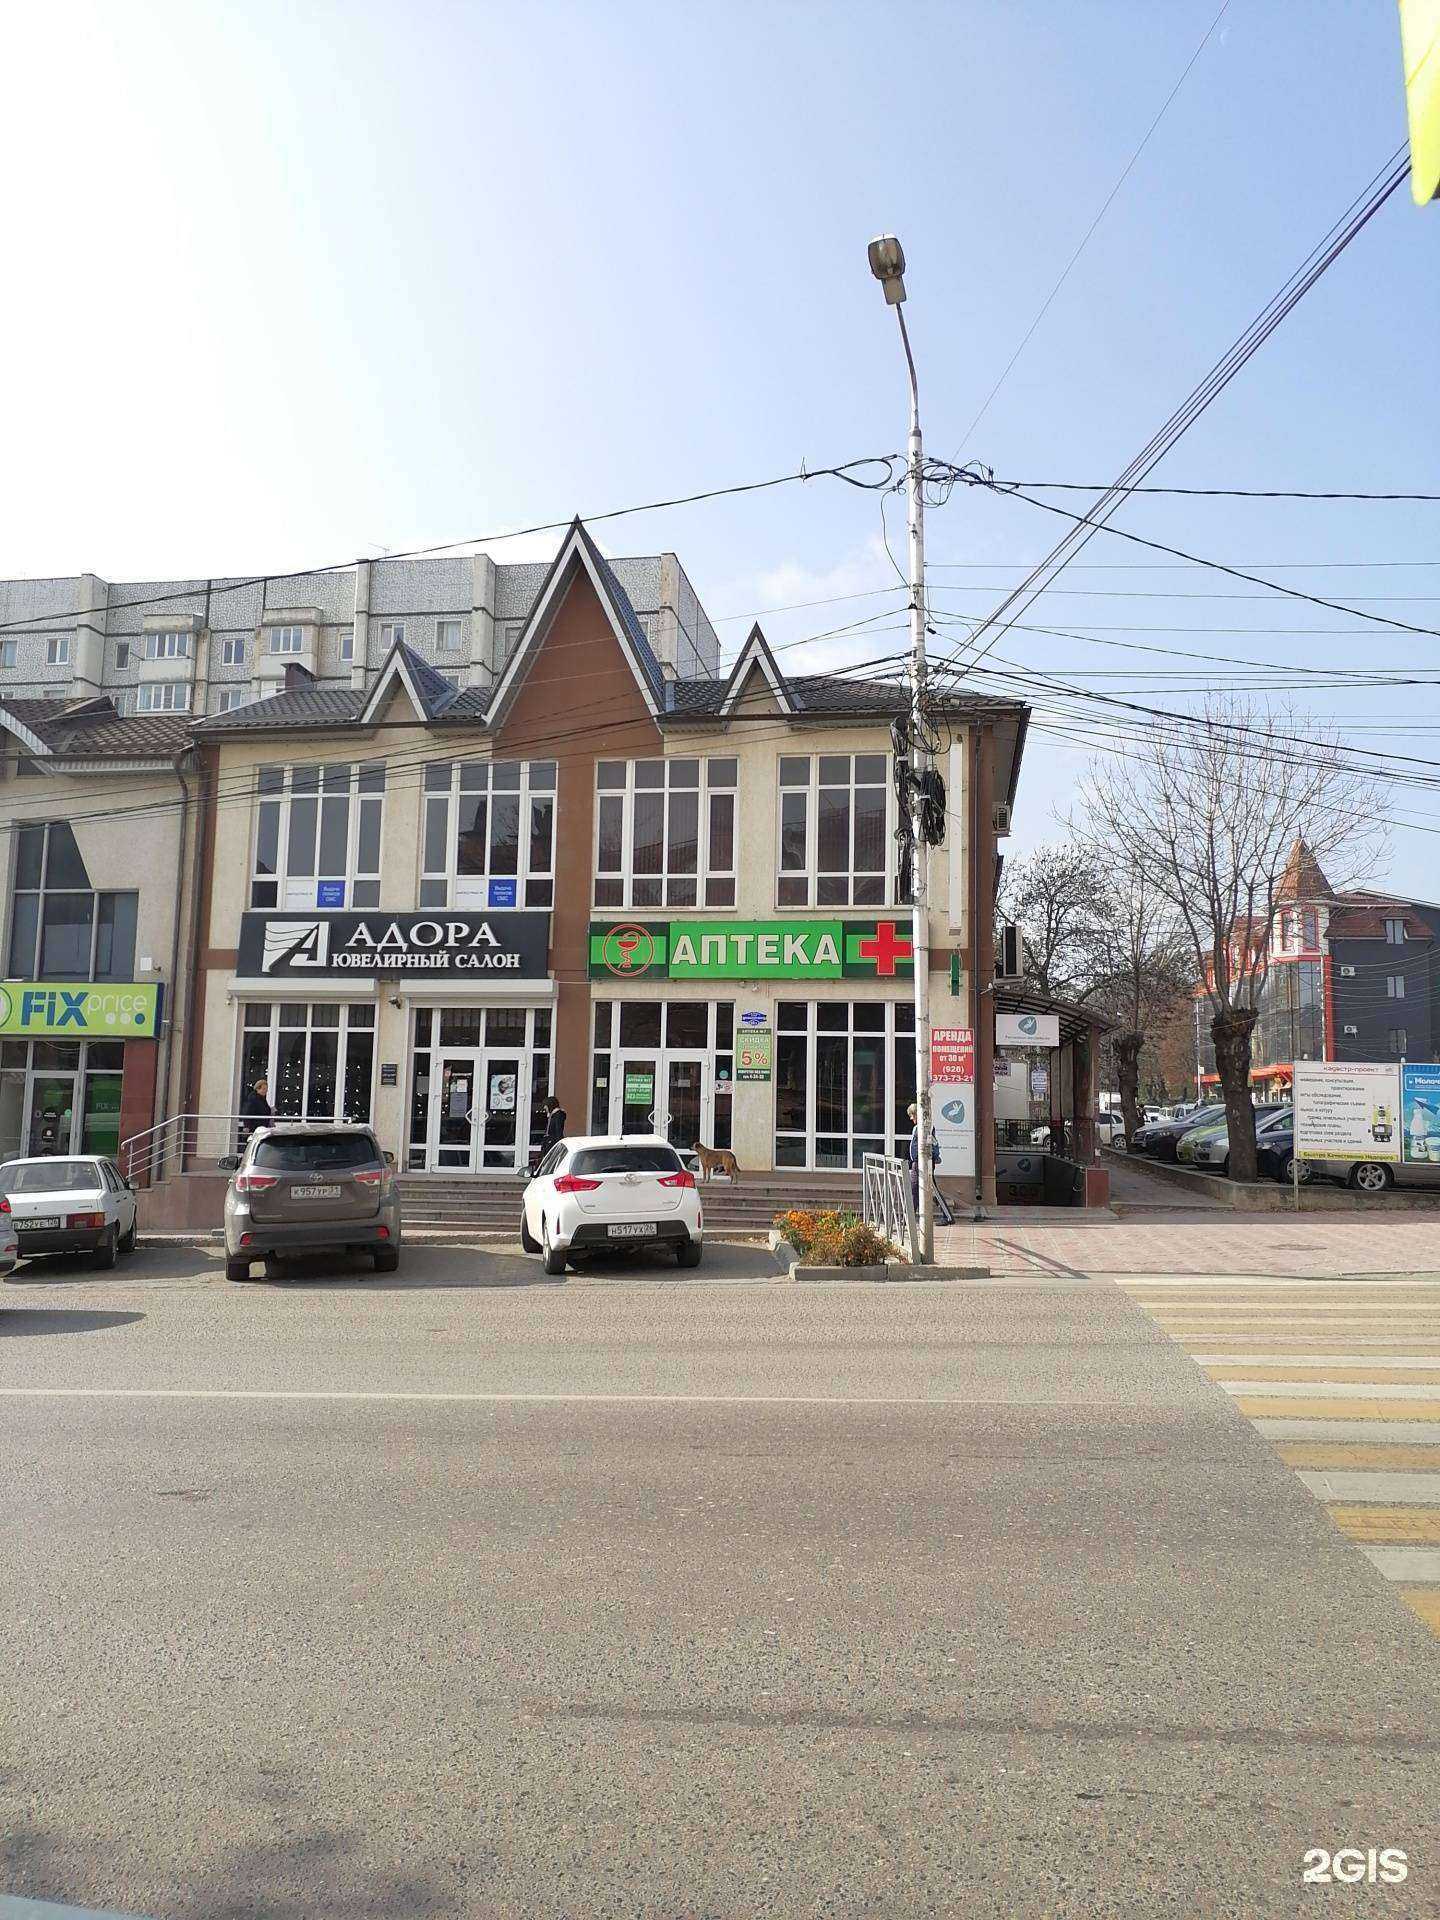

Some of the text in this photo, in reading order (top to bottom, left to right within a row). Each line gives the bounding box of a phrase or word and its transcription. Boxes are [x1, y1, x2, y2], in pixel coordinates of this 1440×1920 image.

[345, 921, 501, 952] АДОРА
[671, 934, 841, 965] АПТЕКА
[331, 950, 521, 969] ЮВЕЛИРНЫЙ САЛОН
[88, 994, 148, 1015] price
[933, 1030, 972, 1043] АРЕНДА
[948, 1054, 957, 1062] 30
[932, 1074, 973, 1082] 373-73-21
